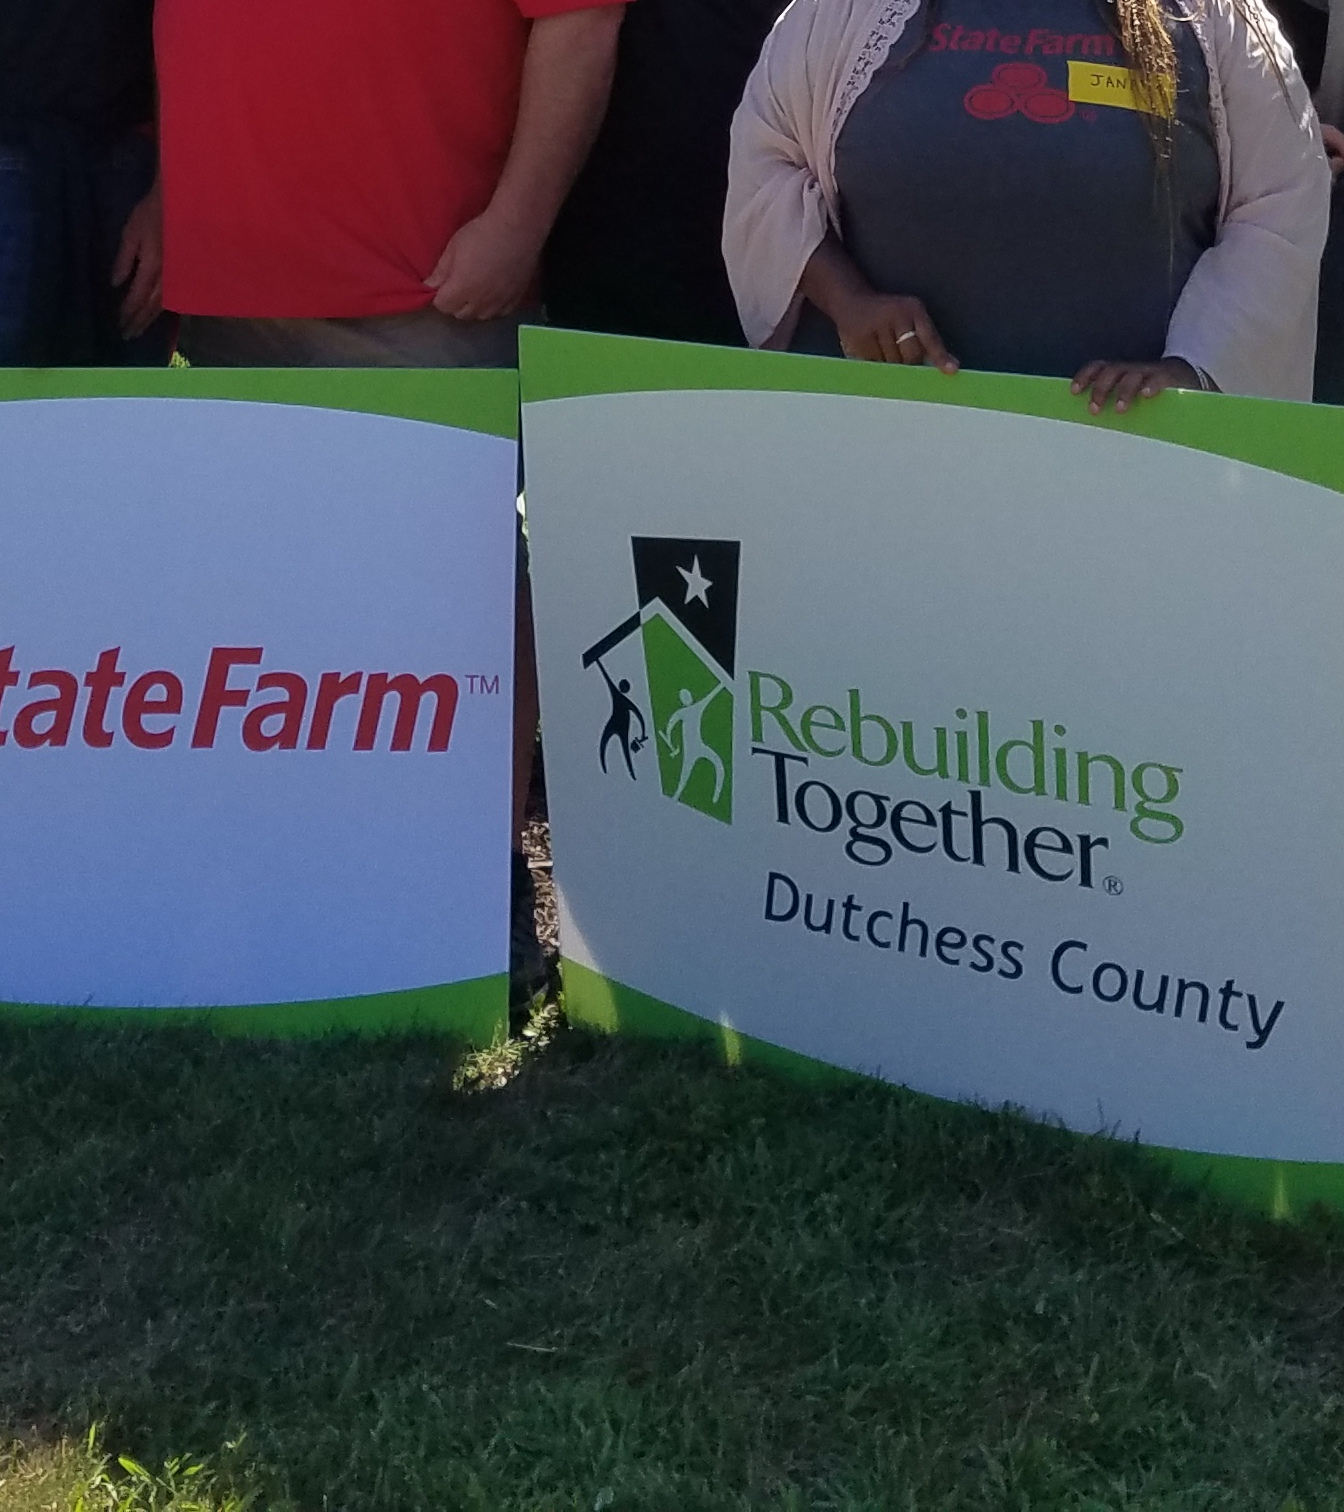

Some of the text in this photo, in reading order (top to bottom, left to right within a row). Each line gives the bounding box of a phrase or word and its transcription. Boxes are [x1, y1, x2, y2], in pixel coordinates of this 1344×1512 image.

[747, 669, 1187, 846] Rebuilding
[763, 871, 1286, 1051] Dutchess County
